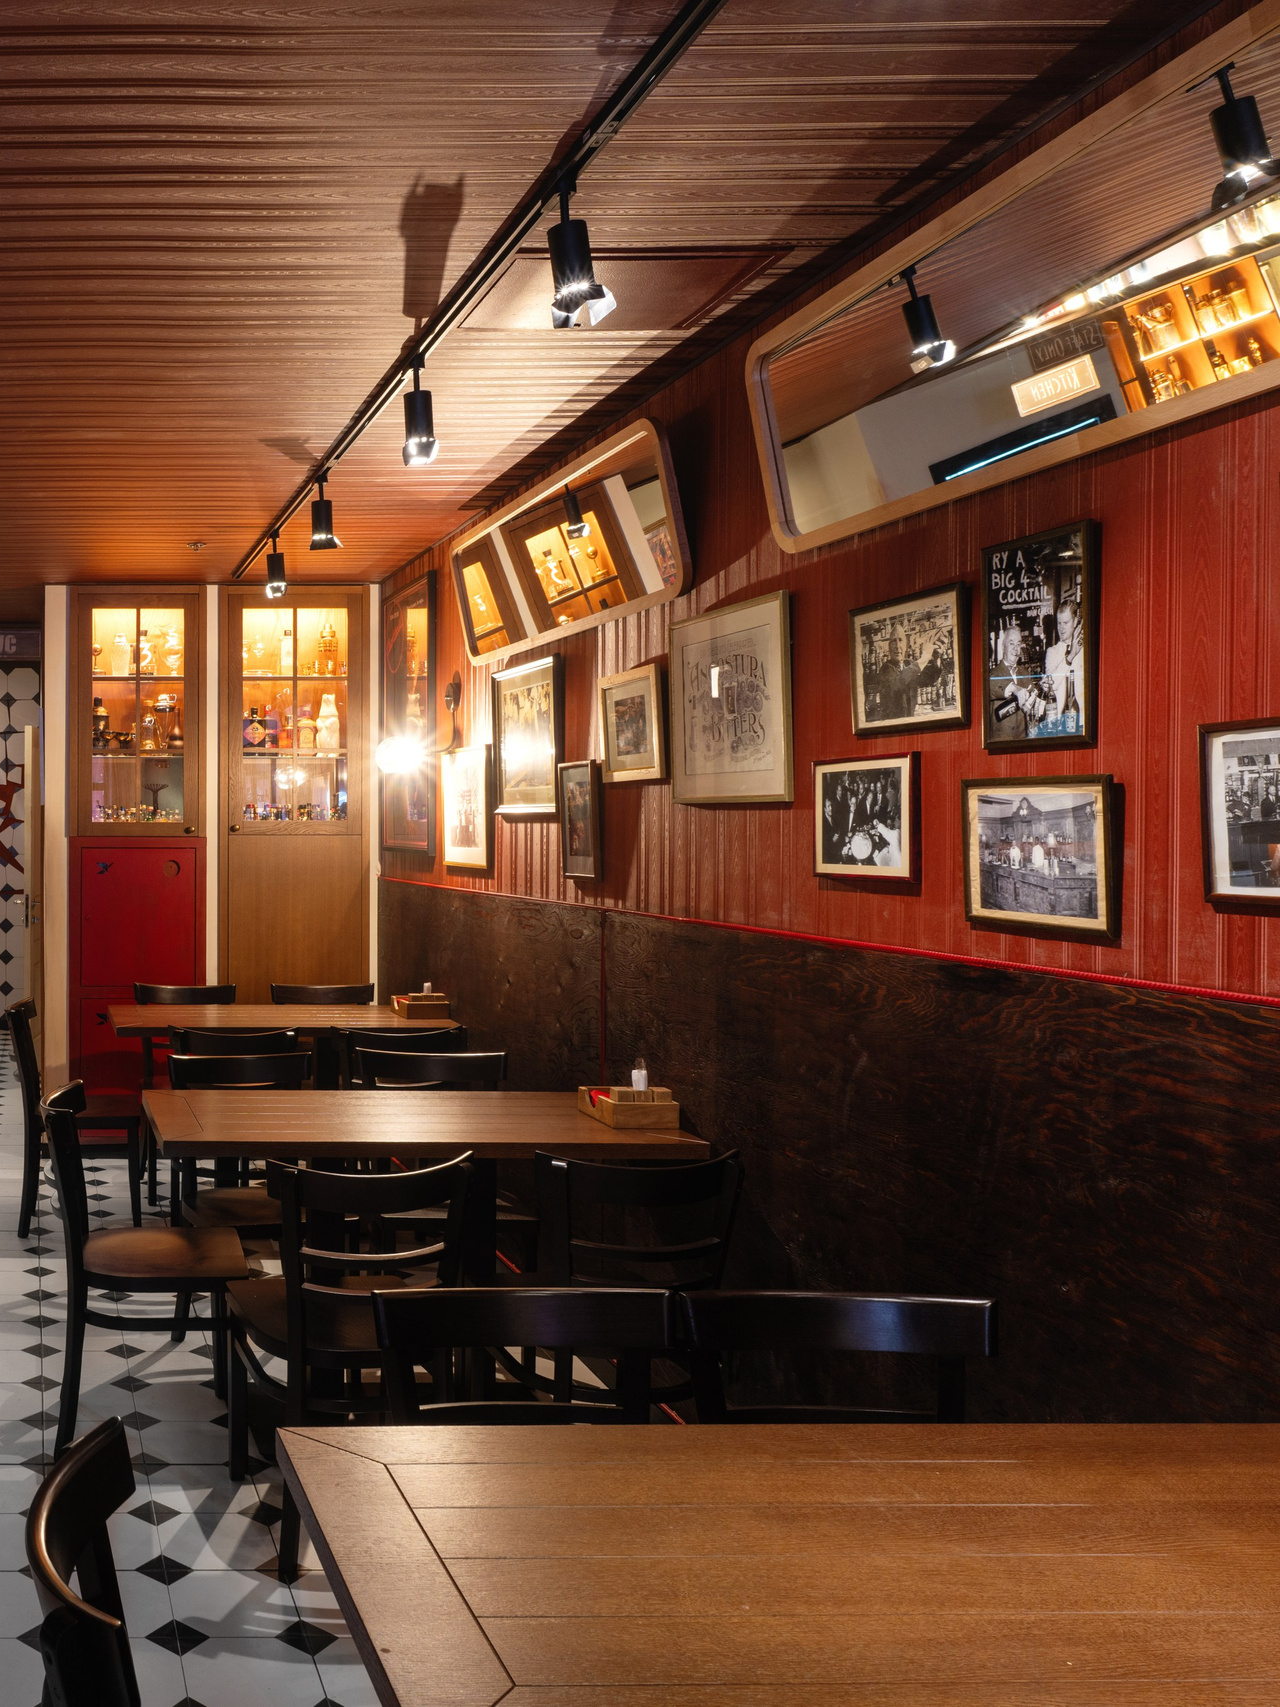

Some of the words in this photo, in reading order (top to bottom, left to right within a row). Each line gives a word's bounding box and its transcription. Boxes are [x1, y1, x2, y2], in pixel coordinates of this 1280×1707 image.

[992, 551, 1008, 570] RY
[1016, 550, 1025, 568] A
[1020, 569, 1030, 589] 4
[999, 585, 1051, 604] COCKTAIL
[687, 653, 768, 692] ANGOSTURA
[711, 712, 766, 746] BITTERS
